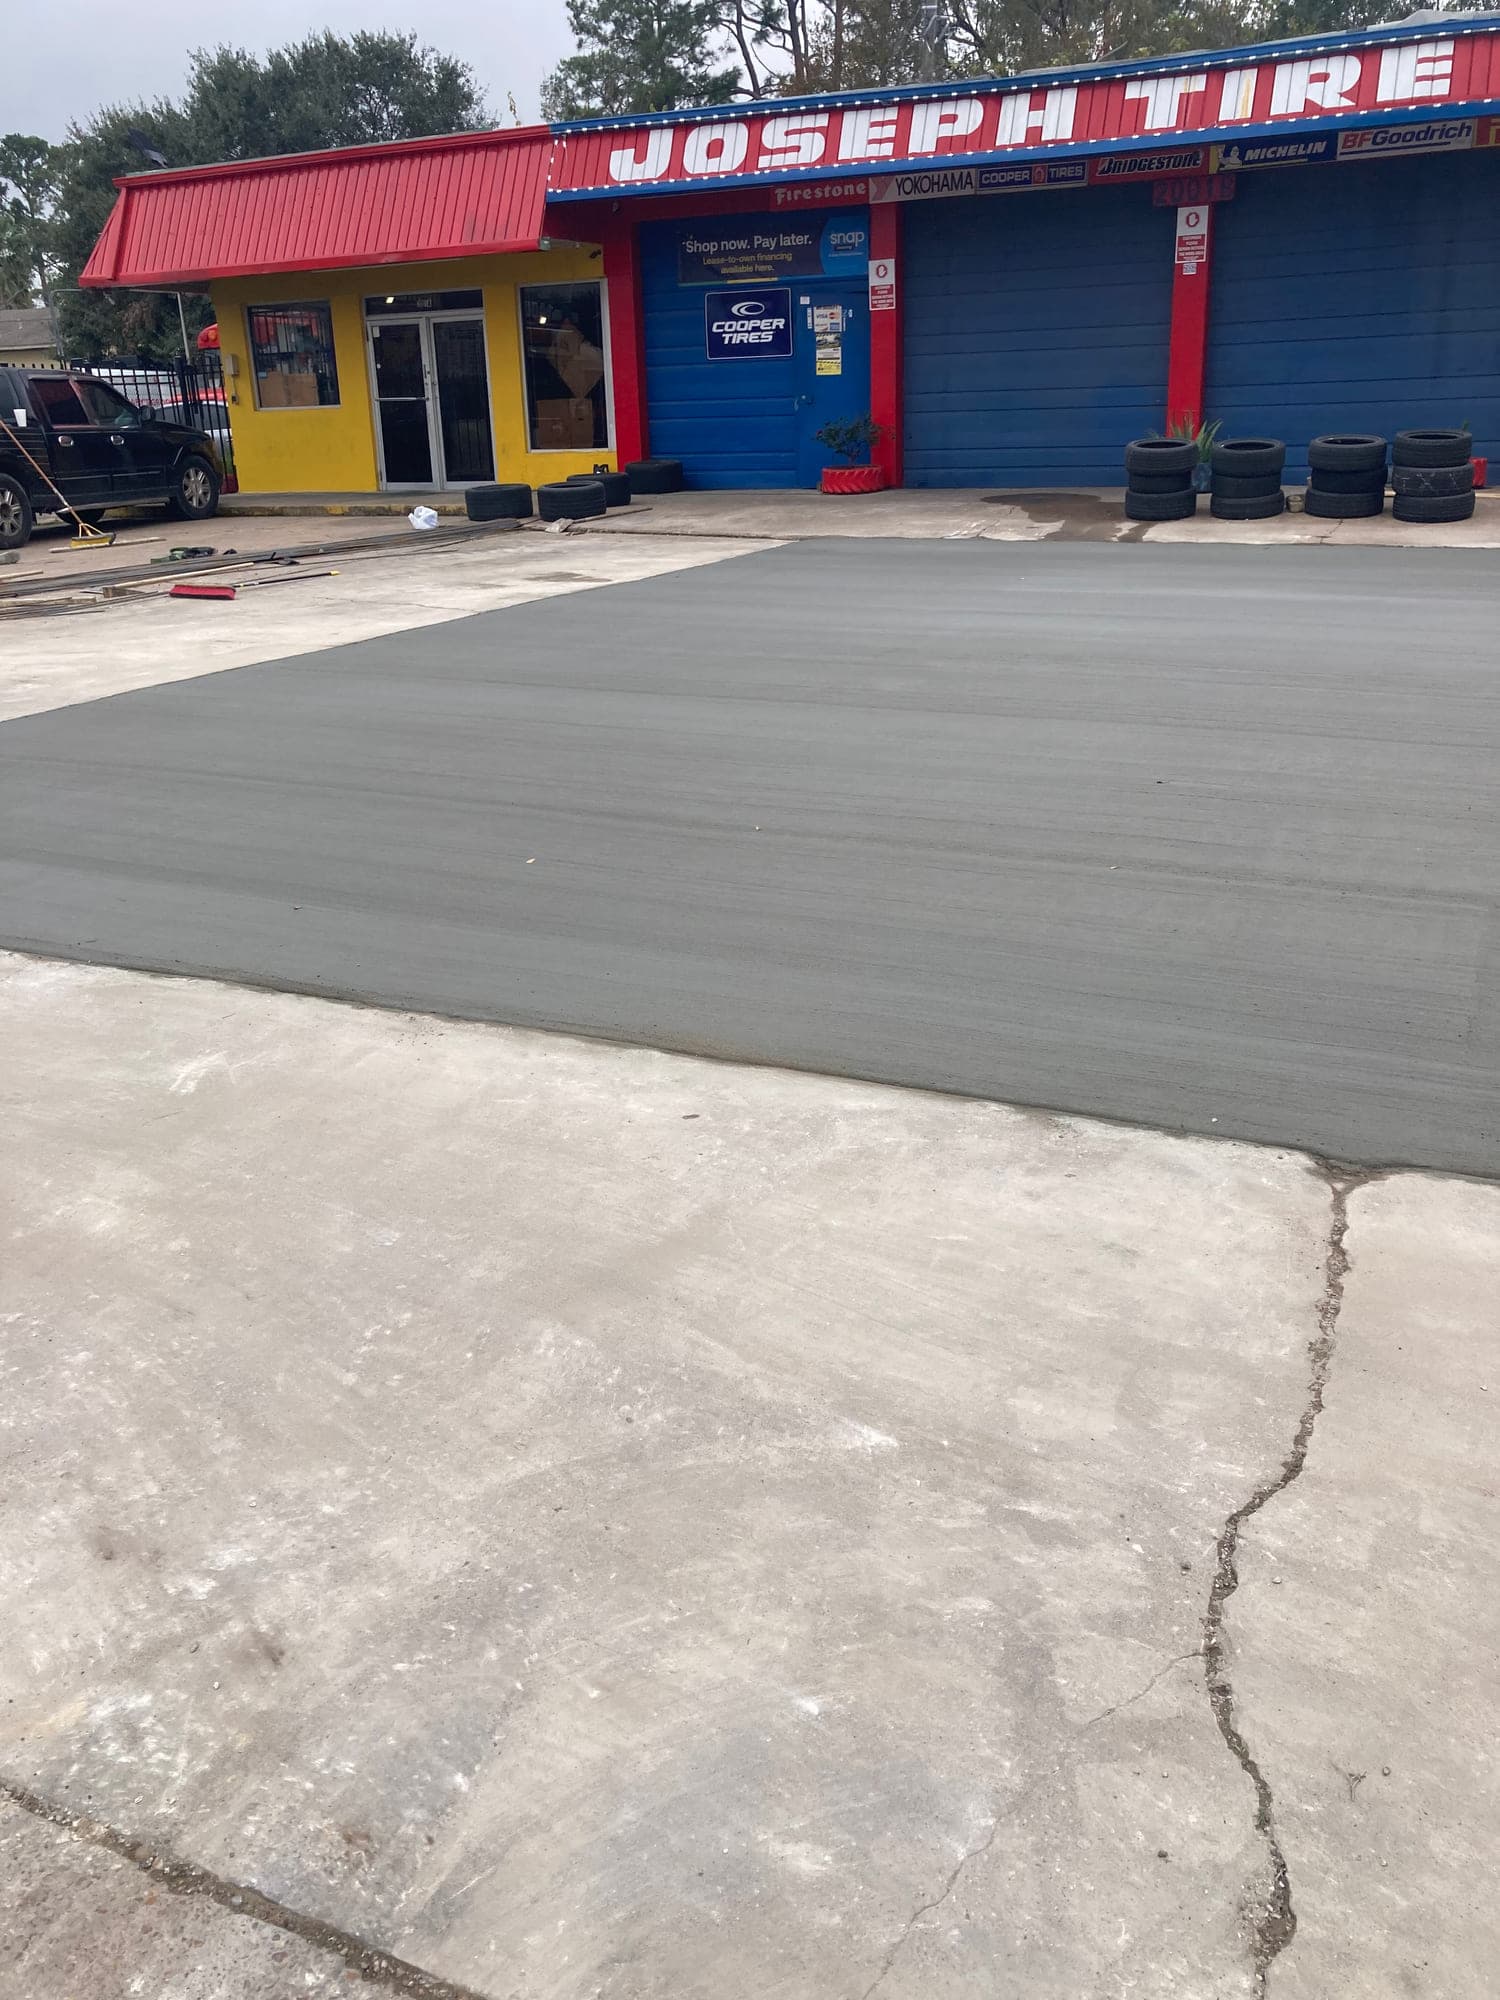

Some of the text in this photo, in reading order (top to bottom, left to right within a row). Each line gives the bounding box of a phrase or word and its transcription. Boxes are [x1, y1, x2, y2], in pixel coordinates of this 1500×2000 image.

[609, 40, 1454, 181] JOSEPH TIRE
[1342, 121, 1473, 149] BFGoodrich
[1244, 141, 1328, 161] MICHELIN
[1097, 151, 1202, 176] BRIDGESTONE
[895, 171, 974, 196] YOKOHAMA
[982, 165, 1084, 185] COOPER TIRES
[775, 181, 867, 205] Firestone
[686, 232, 813, 254] Shop now. Pay later.
[830, 231, 865, 247] snap
[757, 252, 793, 263] financing
[712, 318, 785, 333] COOPER
[722, 331, 774, 344] TIRES
